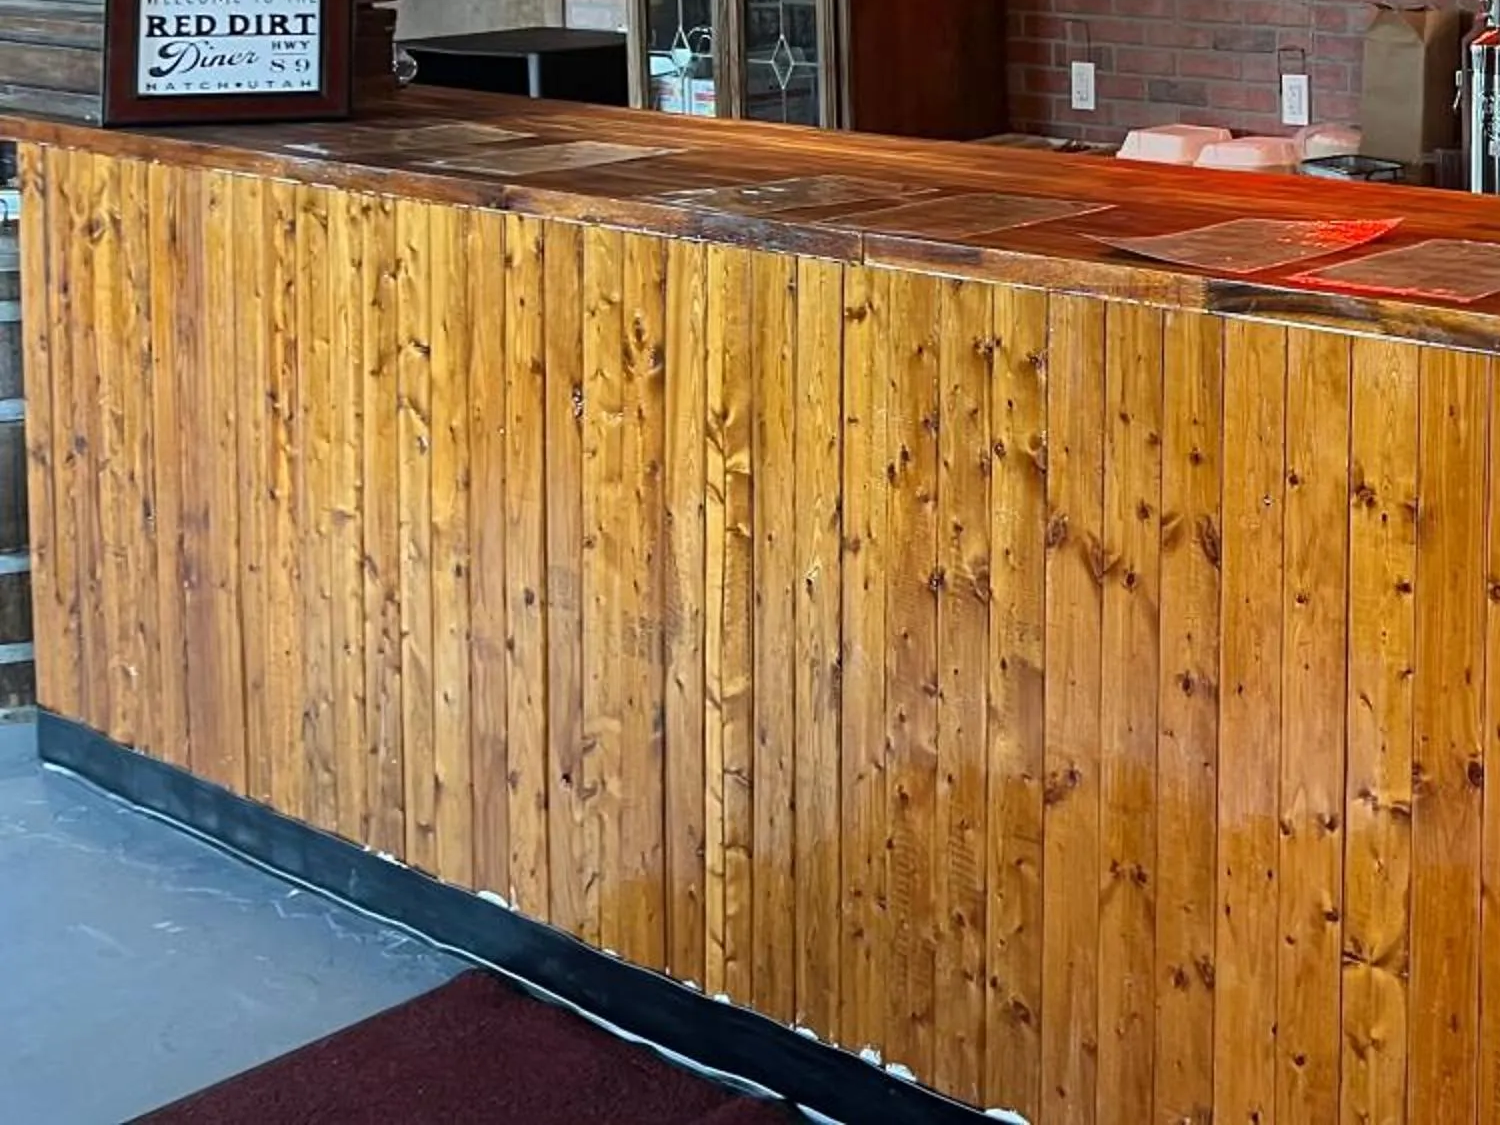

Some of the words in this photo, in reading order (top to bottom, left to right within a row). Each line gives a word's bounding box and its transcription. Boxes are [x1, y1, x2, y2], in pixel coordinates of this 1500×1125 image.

[145, 14, 216, 38] RED
[228, 13, 316, 36] DIRT
[271, 39, 311, 51] HWY
[148, 39, 260, 78] Diner
[269, 58, 311, 74] 89
